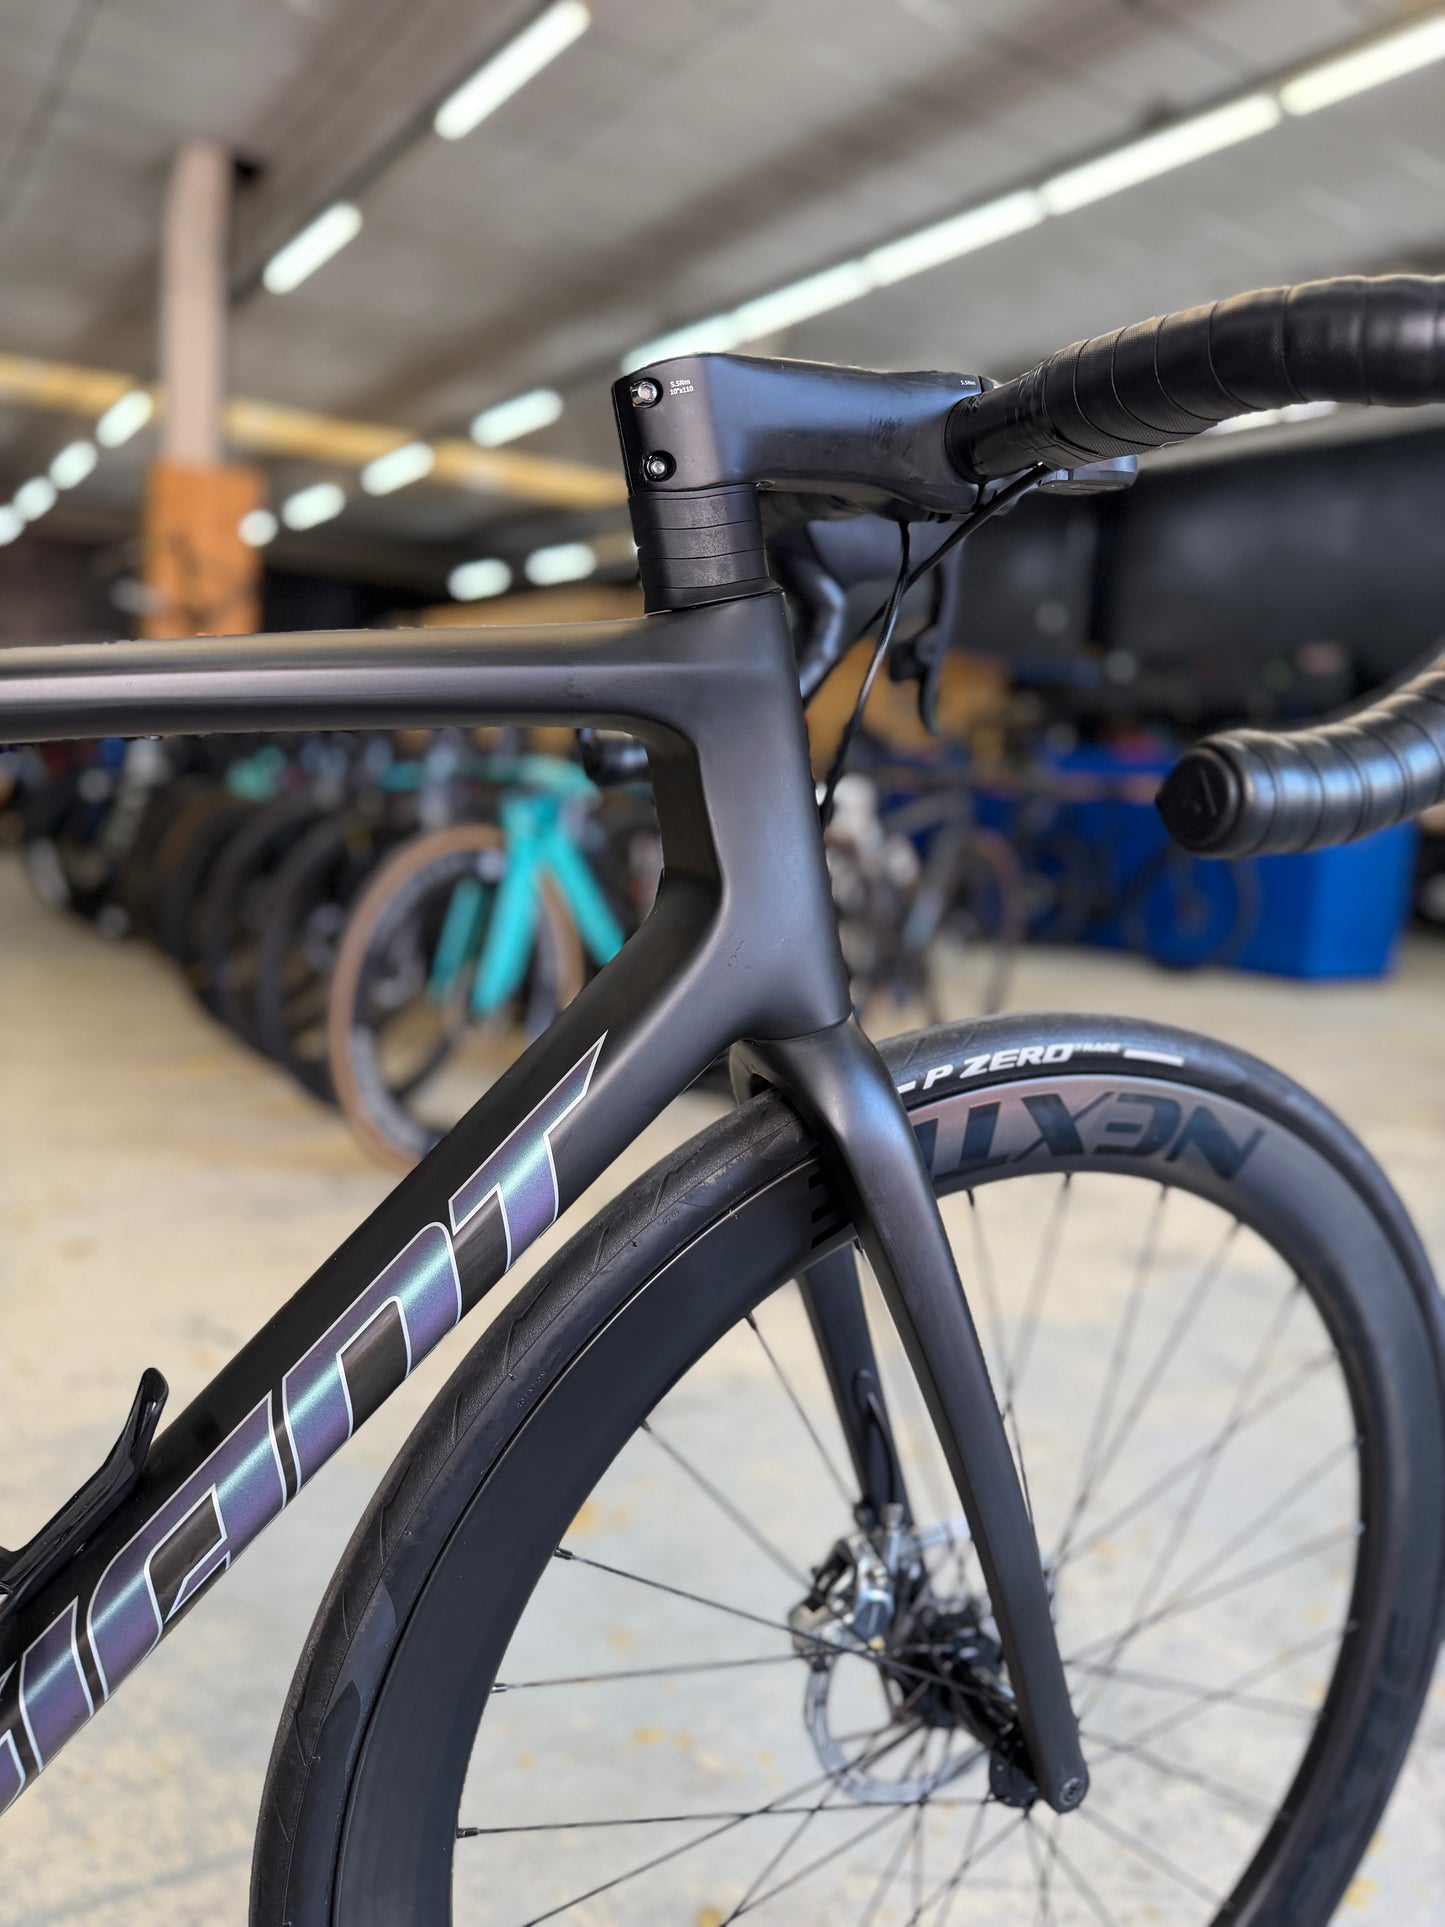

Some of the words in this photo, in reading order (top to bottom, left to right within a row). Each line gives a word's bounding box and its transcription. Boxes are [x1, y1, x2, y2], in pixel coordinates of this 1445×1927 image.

[670, 379, 691, 388] 5.5Nm
[922, 1064, 954, 1091] P
[959, 1043, 1073, 1079] ZERO
[0, 1031, 607, 1815] IANT
